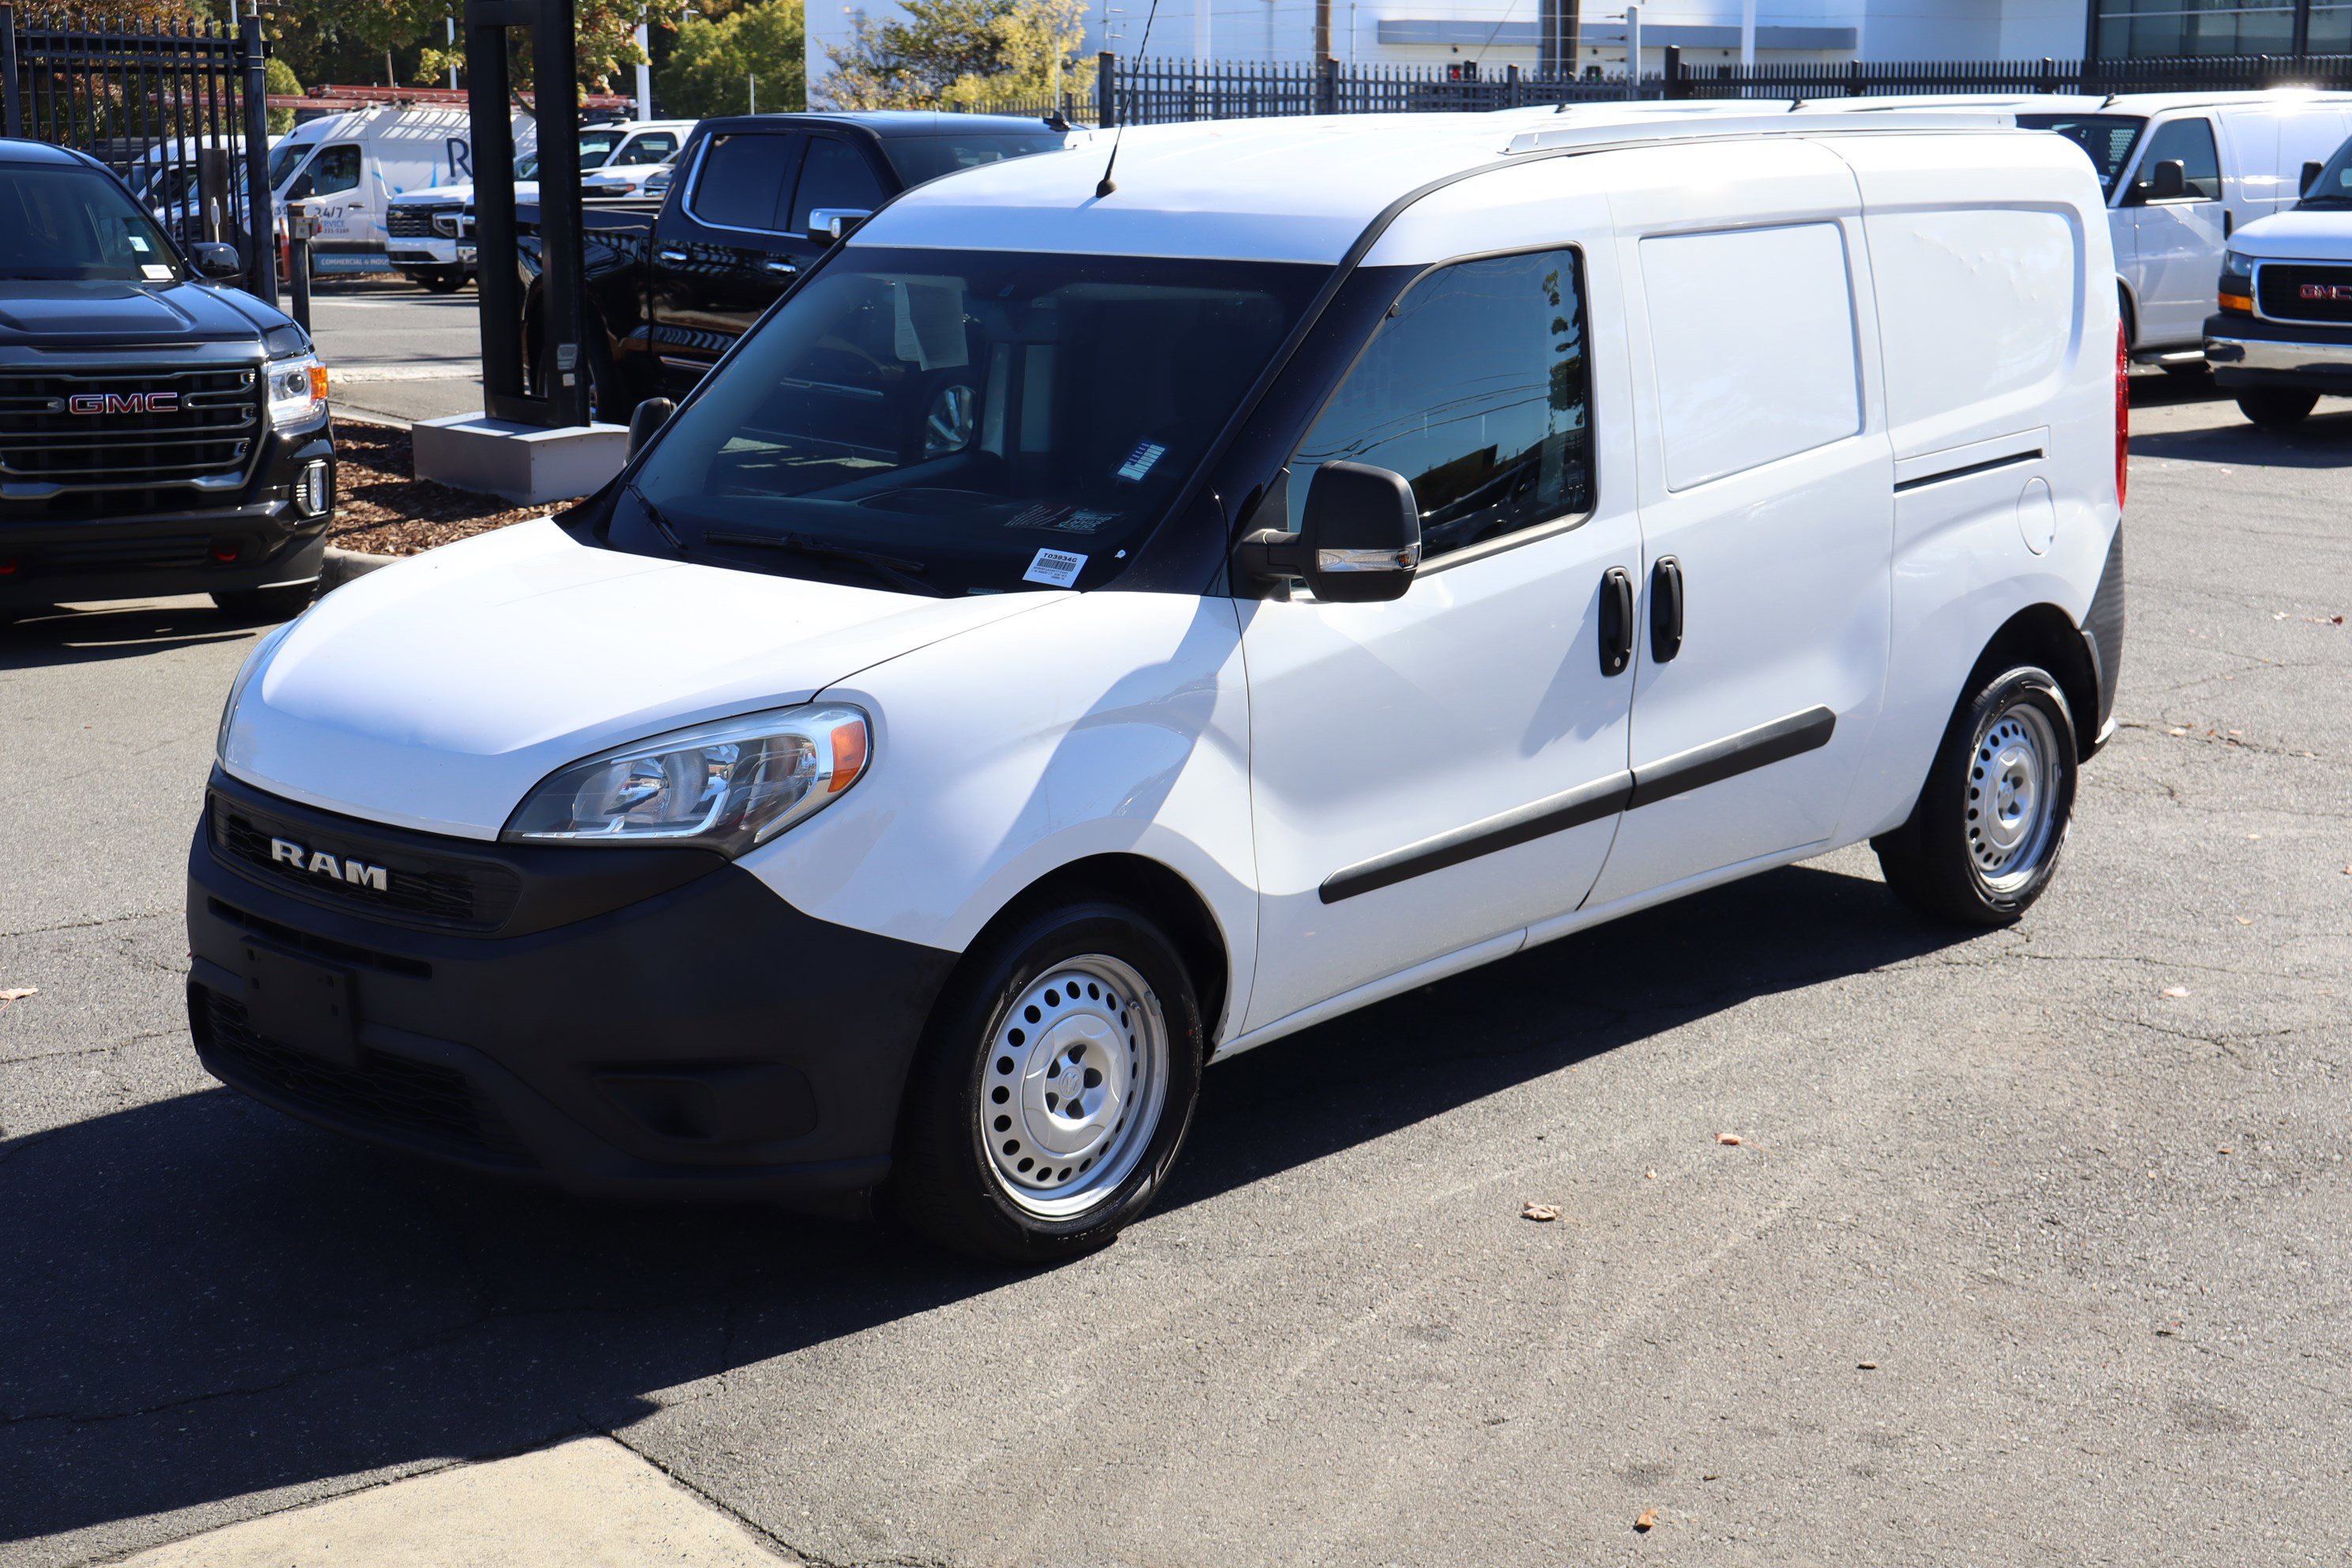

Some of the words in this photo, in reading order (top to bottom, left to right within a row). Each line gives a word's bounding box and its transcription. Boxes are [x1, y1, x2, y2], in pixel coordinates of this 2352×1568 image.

[315, 206, 343, 218] 24/7
[321, 257, 363, 266] COMMERCIAL
[371, 257, 390, 266] INDUS
[2300, 284, 2352, 300] GMC
[70, 392, 179, 415] GMC
[272, 837, 387, 891] RAM
